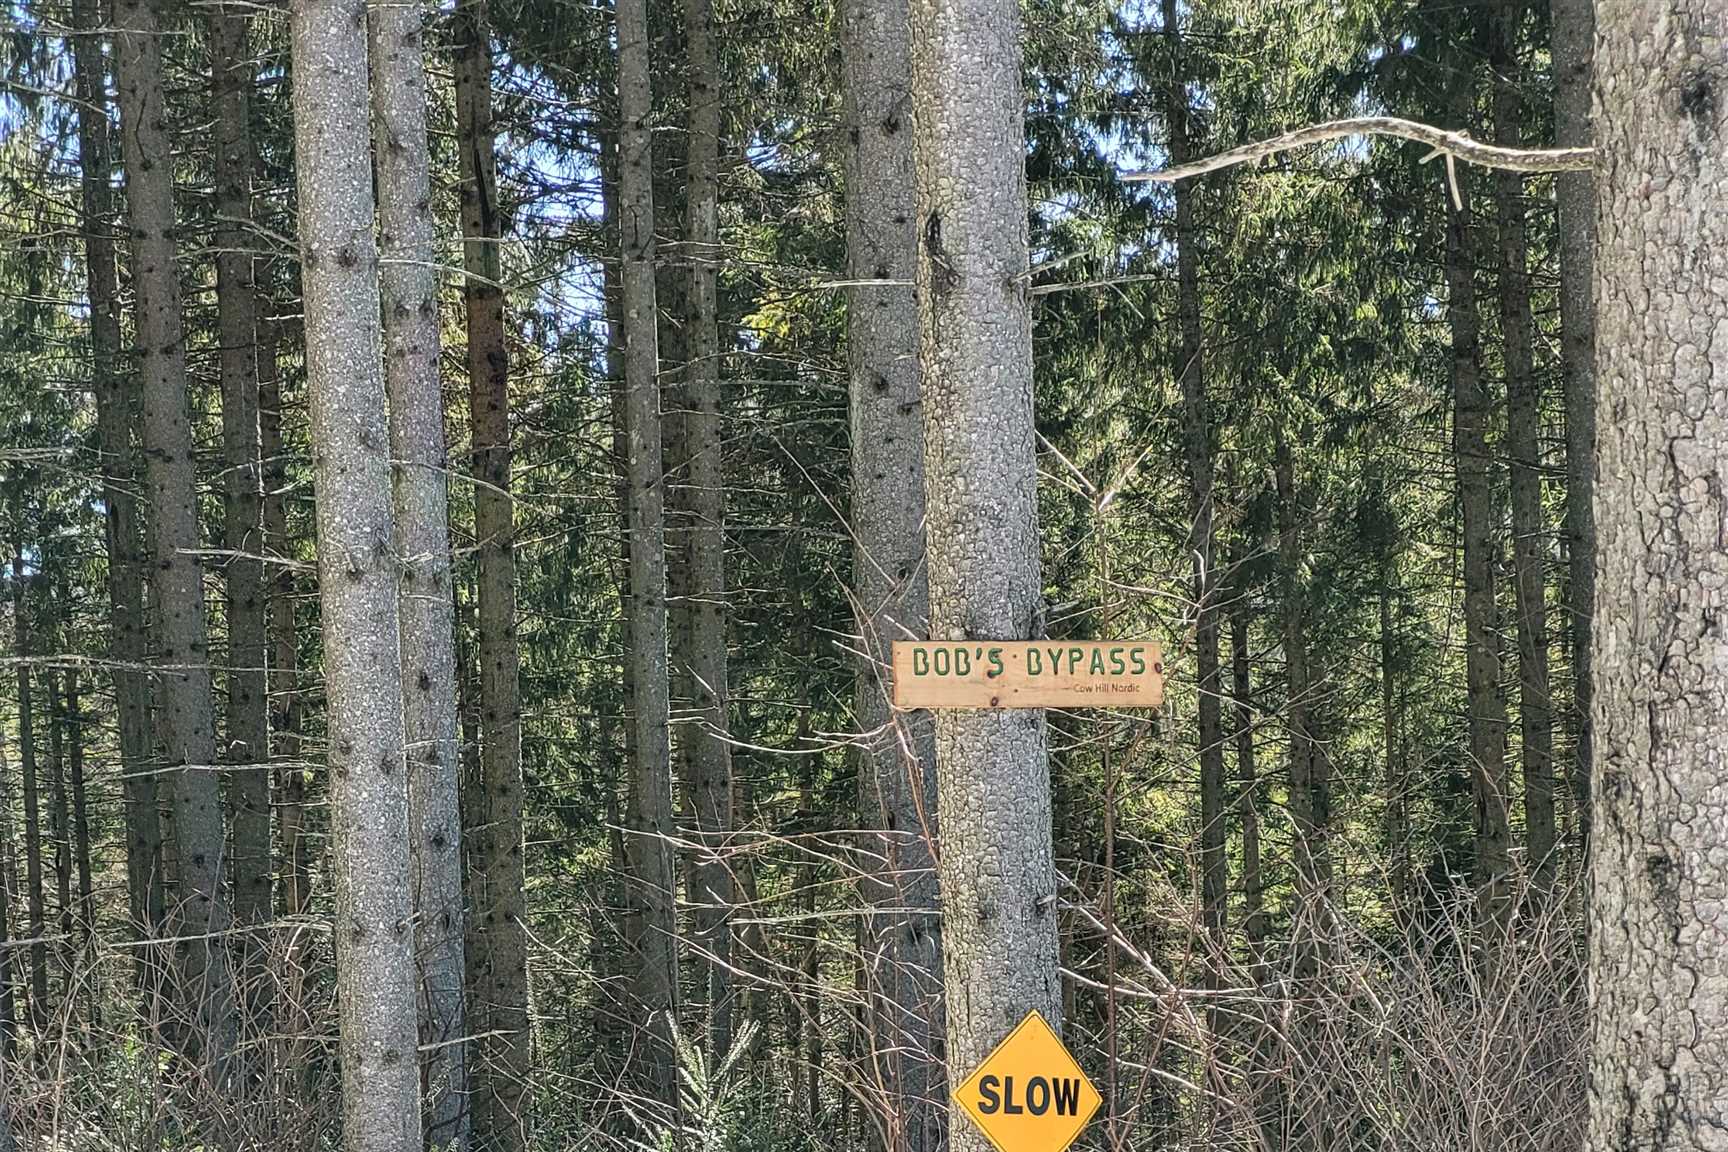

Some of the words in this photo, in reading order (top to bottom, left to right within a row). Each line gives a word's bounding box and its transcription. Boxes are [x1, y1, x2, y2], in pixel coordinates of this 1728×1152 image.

[913, 647, 1004, 676] BOB'S
[1026, 647, 1146, 675] BYPASS
[1073, 683, 1093, 693] Cow
[1095, 682, 1109, 693] Hill
[1111, 682, 1141, 693] Nordic
[977, 1074, 1081, 1116] SLOW
